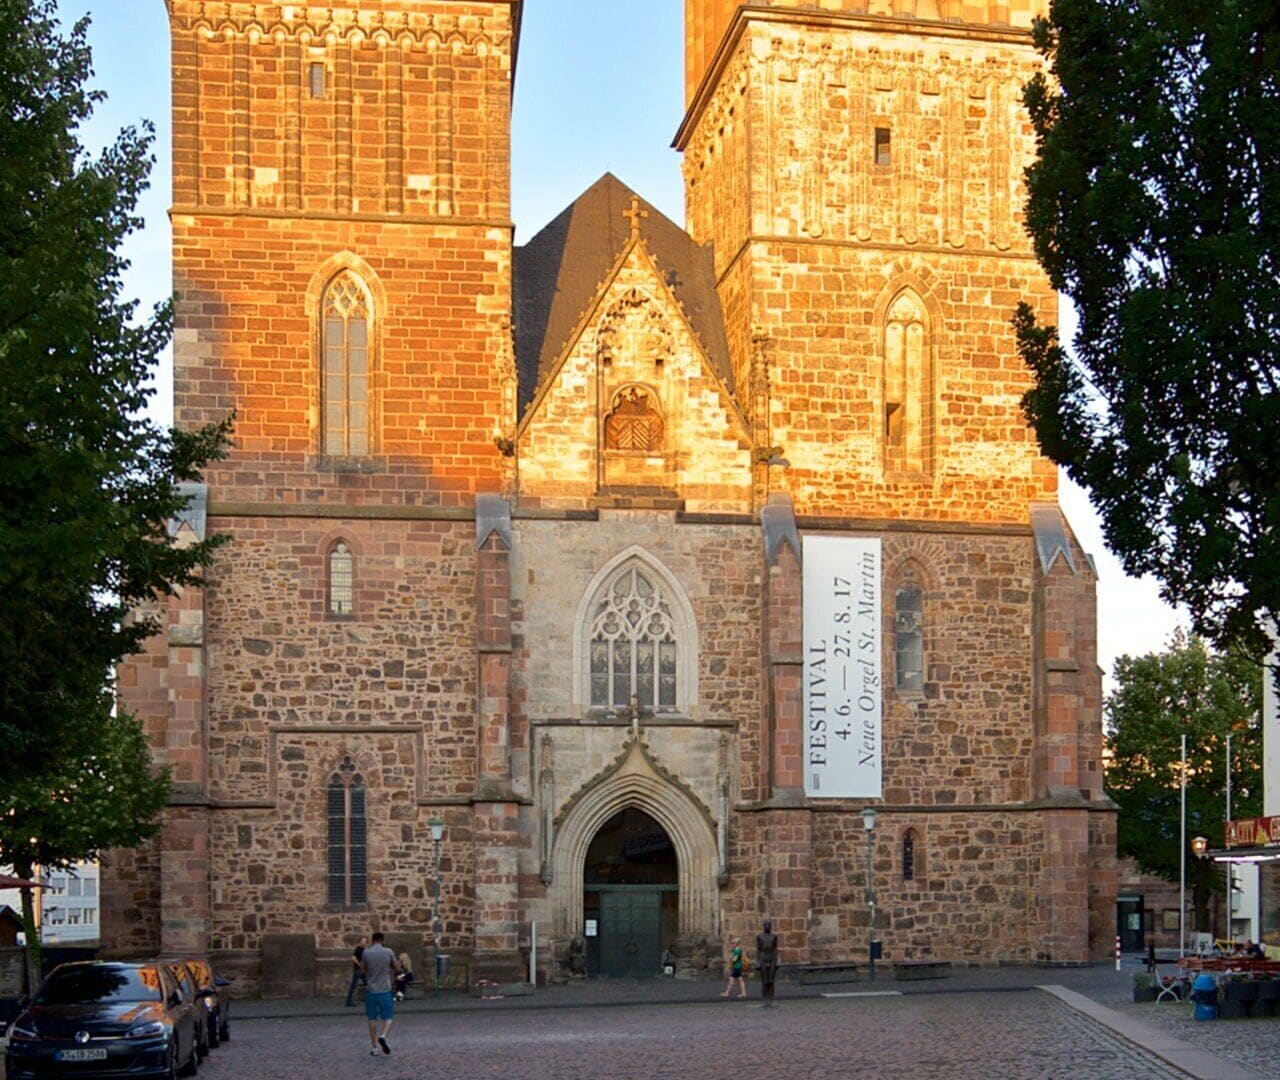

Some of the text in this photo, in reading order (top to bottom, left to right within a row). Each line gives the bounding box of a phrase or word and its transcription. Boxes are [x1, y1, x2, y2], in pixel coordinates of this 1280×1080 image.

[833, 576, 851, 598] 17
[857, 551, 880, 768] Neue Orgel St. Martin
[809, 639, 828, 767] FESTIVAL
[1236, 820, 1256, 844] CITY
